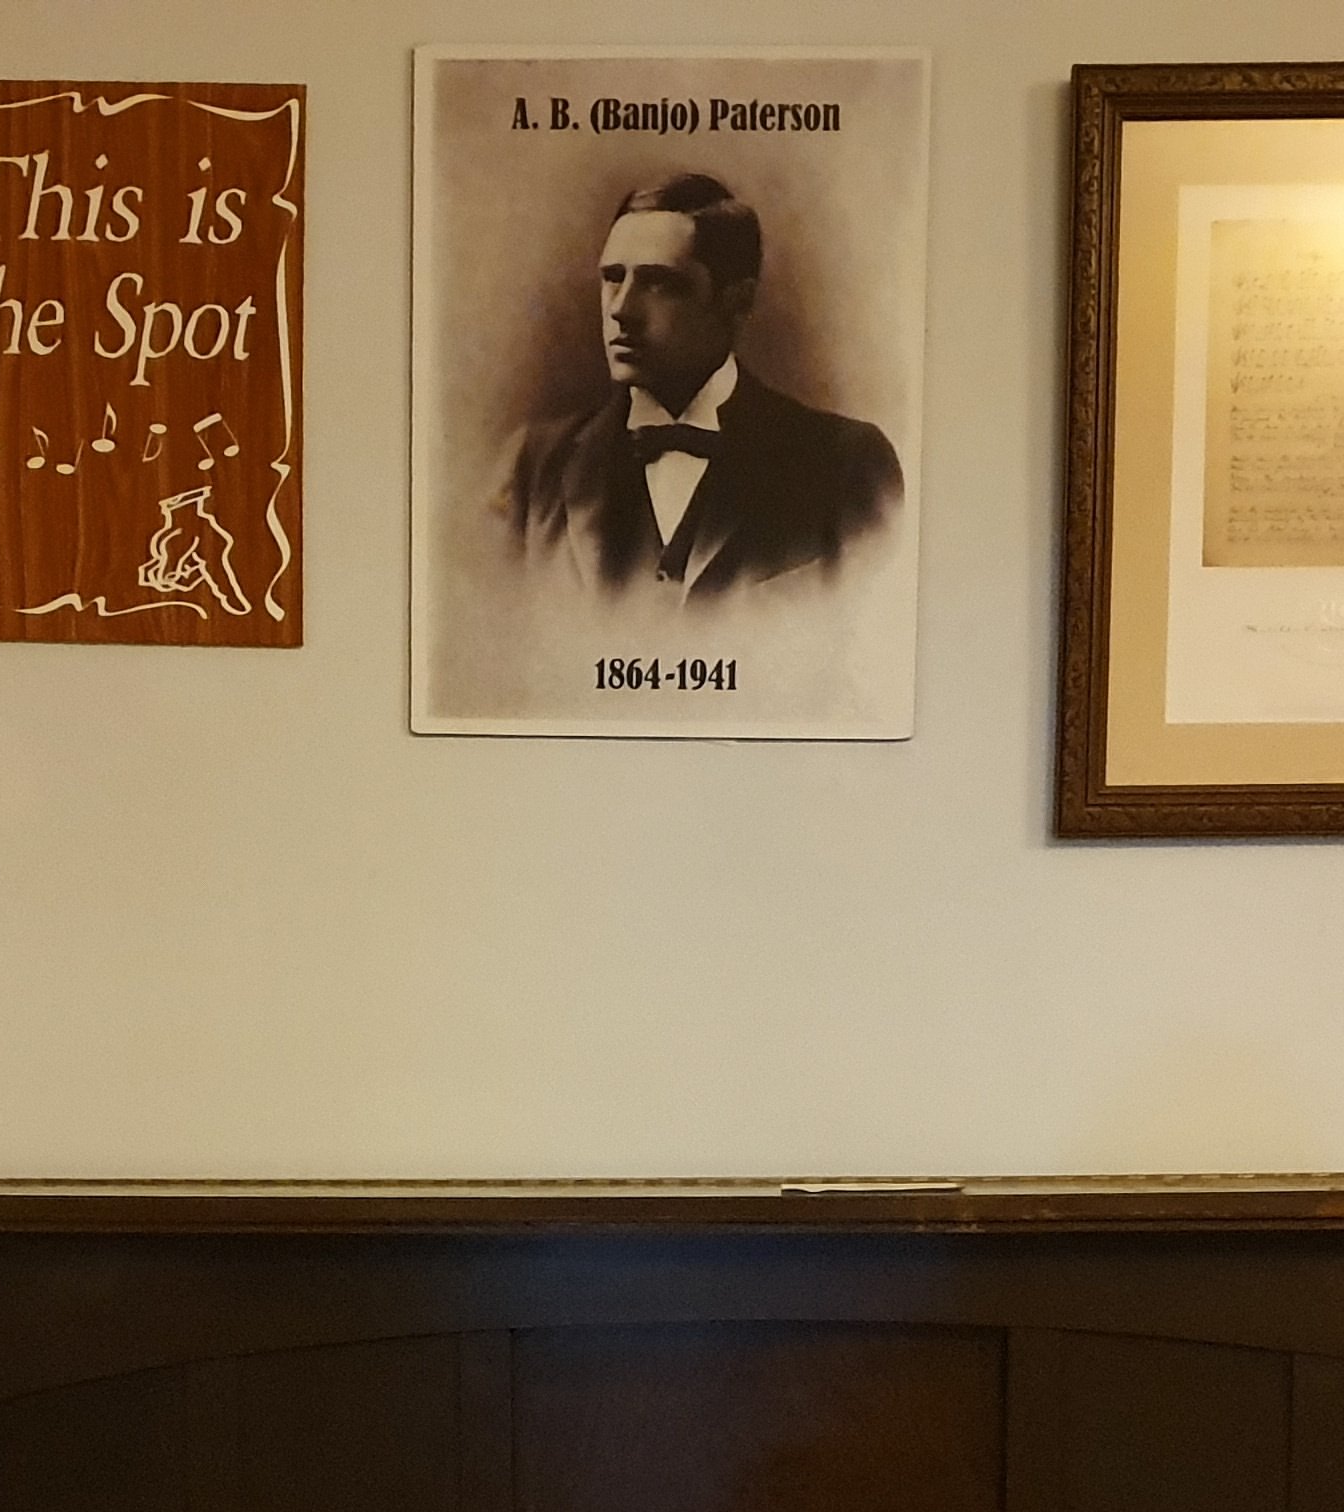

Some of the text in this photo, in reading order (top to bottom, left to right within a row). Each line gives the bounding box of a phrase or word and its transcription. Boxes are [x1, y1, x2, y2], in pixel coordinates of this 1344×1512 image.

[511, 97, 841, 136] A. B. (Banjo) Paterson
[179, 157, 247, 245] is
[95, 272, 257, 387] Spot
[595, 658, 737, 691] 1864-1941
